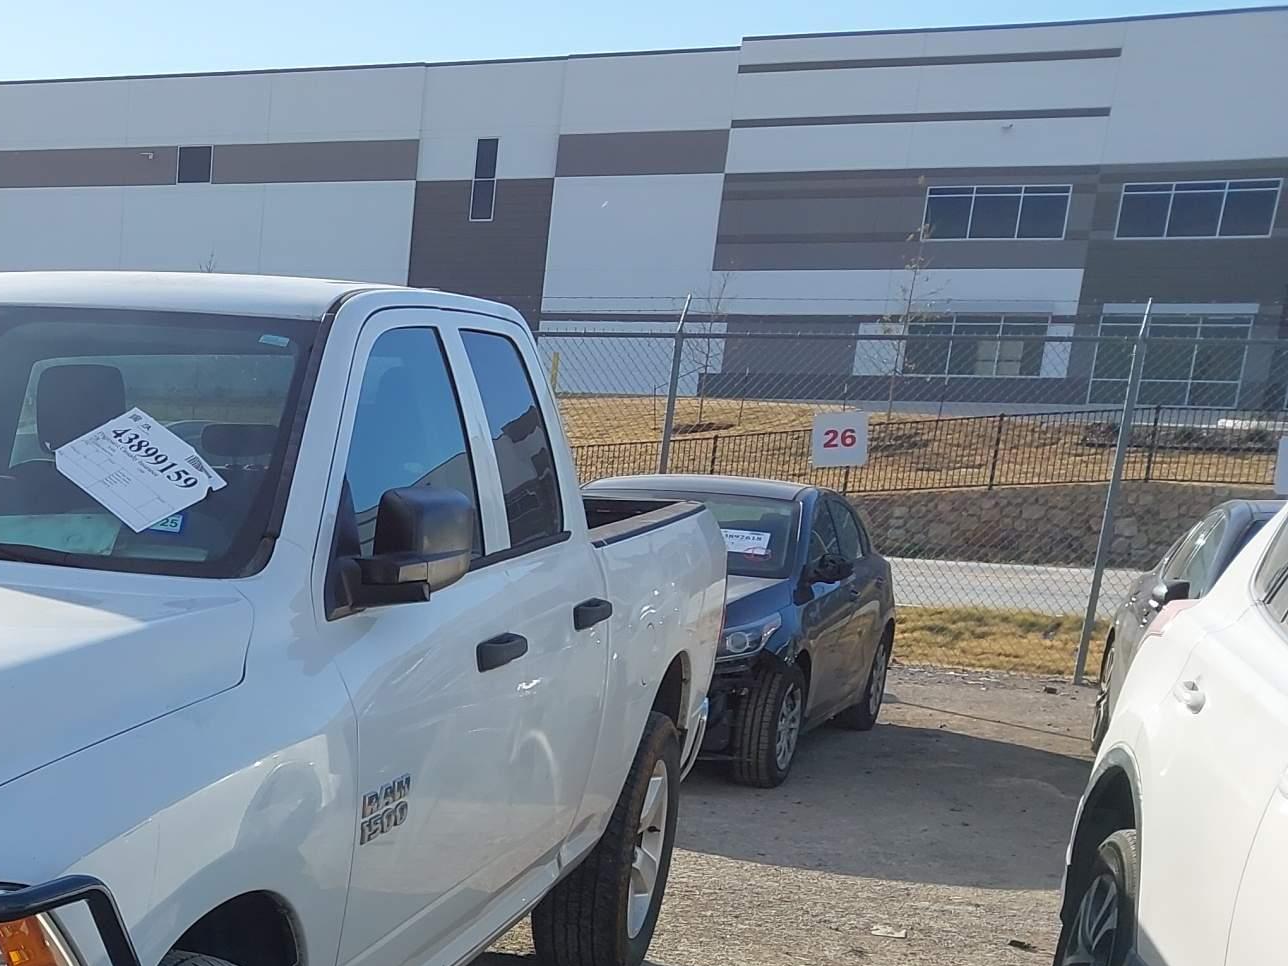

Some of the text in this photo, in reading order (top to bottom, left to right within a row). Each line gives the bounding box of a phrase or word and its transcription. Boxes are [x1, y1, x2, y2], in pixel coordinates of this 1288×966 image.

[112, 428, 198, 488] 43899159
[824, 428, 857, 448] 26
[159, 516, 178, 528] 25
[361, 774, 411, 820] RAM
[359, 800, 409, 846] 1500
